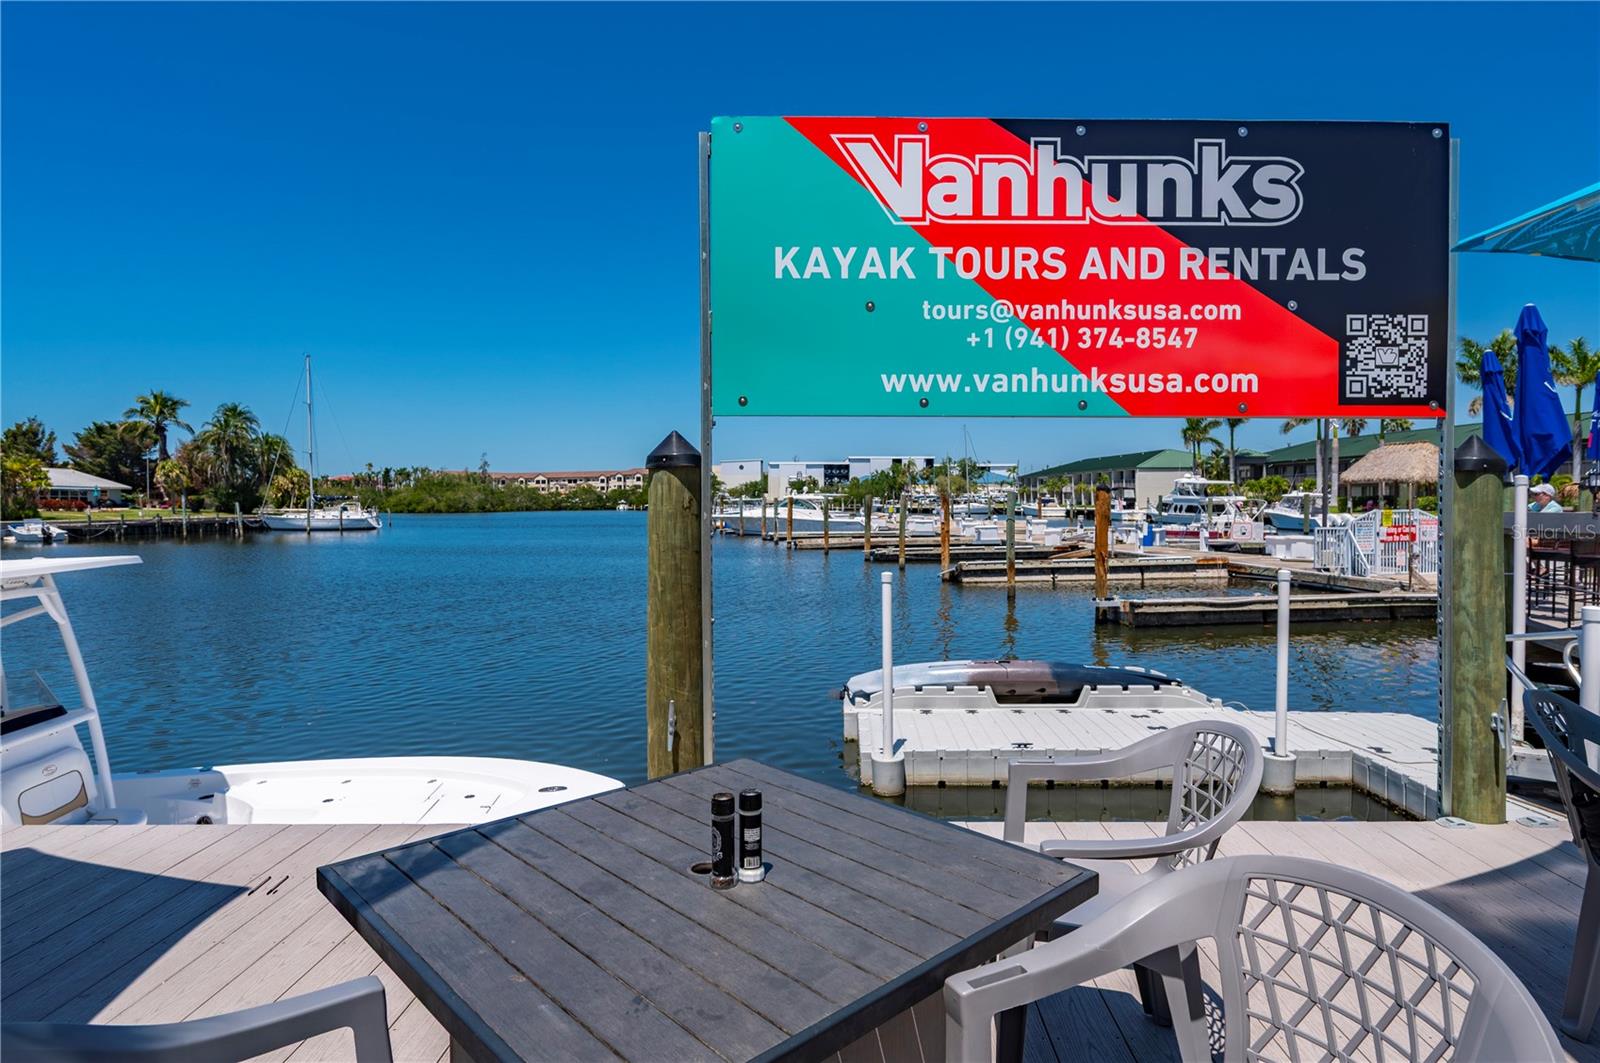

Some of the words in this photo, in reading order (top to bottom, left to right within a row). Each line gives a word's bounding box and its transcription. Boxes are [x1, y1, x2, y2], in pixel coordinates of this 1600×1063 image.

[831, 133, 1305, 227] Vanhunks
[774, 246, 916, 279] KAYAK
[928, 246, 1067, 280] TOURS
[1079, 246, 1165, 280] AND
[1179, 246, 1366, 281] RENTALS
[922, 299, 1241, 322] tours@vanhunksusa.com
[967, 327, 993, 348] +1
[1005, 326, 1069, 350] (941)
[1077, 327, 1198, 349] 374-8547
[881, 371, 1259, 394] www.vanhunksusa.com
